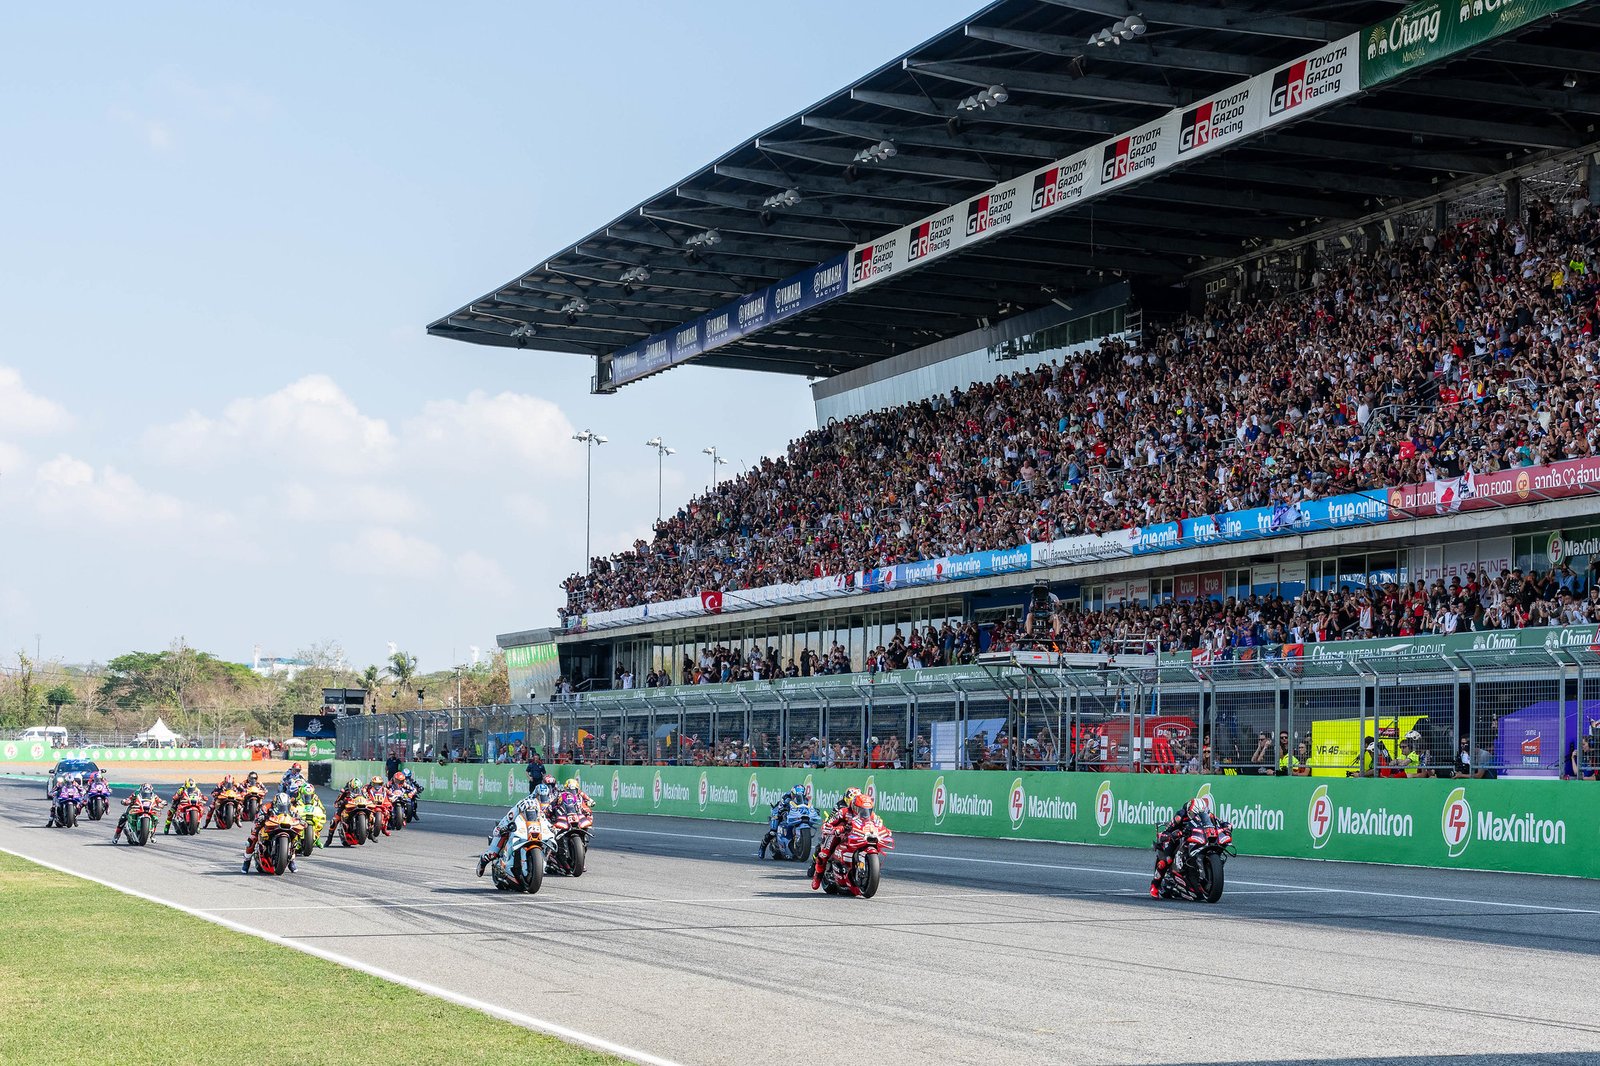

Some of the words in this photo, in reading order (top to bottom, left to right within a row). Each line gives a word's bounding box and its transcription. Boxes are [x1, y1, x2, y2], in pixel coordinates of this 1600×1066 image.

[1389, 10, 1441, 50] Chang
[1309, 46, 1347, 71] TOYOTA
[1306, 63, 1343, 86] GAZOO
[1215, 89, 1249, 112] TOYOTA
[1270, 78, 1303, 114] GR
[1305, 79, 1341, 101] Racing
[1212, 105, 1245, 126] GAZOO
[1131, 127, 1162, 147] TOYOTA
[1179, 119, 1210, 151] GR
[1211, 120, 1243, 140] Racing
[1129, 142, 1157, 160] GAZOO
[1060, 158, 1087, 177] TOYOTA
[1101, 153, 1127, 184] GR
[1128, 155, 1155, 173] Racing
[1058, 172, 1083, 190] GAZOO
[990, 187, 1016, 205] TOYOTA
[1032, 183, 1056, 212] GR
[1057, 185, 1083, 202] Racing
[988, 200, 1013, 216] GAZOO
[931, 214, 954, 230] TOYOTA
[966, 209, 988, 236] GR
[988, 213, 1011, 228] Racing
[928, 238, 950, 253] Racing
[929, 227, 952, 242] GAZOO
[872, 250, 894, 265] GAZOO
[874, 239, 896, 254] TOYOTA
[908, 235, 928, 262] GR
[819, 263, 842, 290] YAMAHA
[853, 259, 872, 282] GR
[871, 261, 892, 275] Racing
[780, 281, 802, 306] YAMAHA
[815, 284, 840, 298] RACING
[743, 296, 764, 320] YAMAHA
[776, 301, 800, 314] RACING
[711, 312, 729, 334] YAMAHA
[740, 315, 763, 328] RACING
[1405, 493, 1420, 507] PUT
[1422, 492, 1436, 506] OUR
[1491, 479, 1513, 495] FOOD
[1180, 580, 1194, 594] true
[1204, 578, 1219, 592] true
[878, 791, 918, 813] Maxnitron
[935, 788, 944, 815] PT
[949, 792, 993, 817] Maxnitron
[1012, 790, 1022, 819] PT
[1028, 795, 1077, 820] Maxnitron
[1100, 793, 1110, 824] PT
[1117, 799, 1174, 825] Maxnitron
[1218, 803, 1284, 831] Maxnitron
[1314, 800, 1328, 835] PT
[1337, 805, 1413, 837] Maxnitron
[1449, 804, 1466, 842] PT
[1477, 810, 1566, 845] Maxnitron
